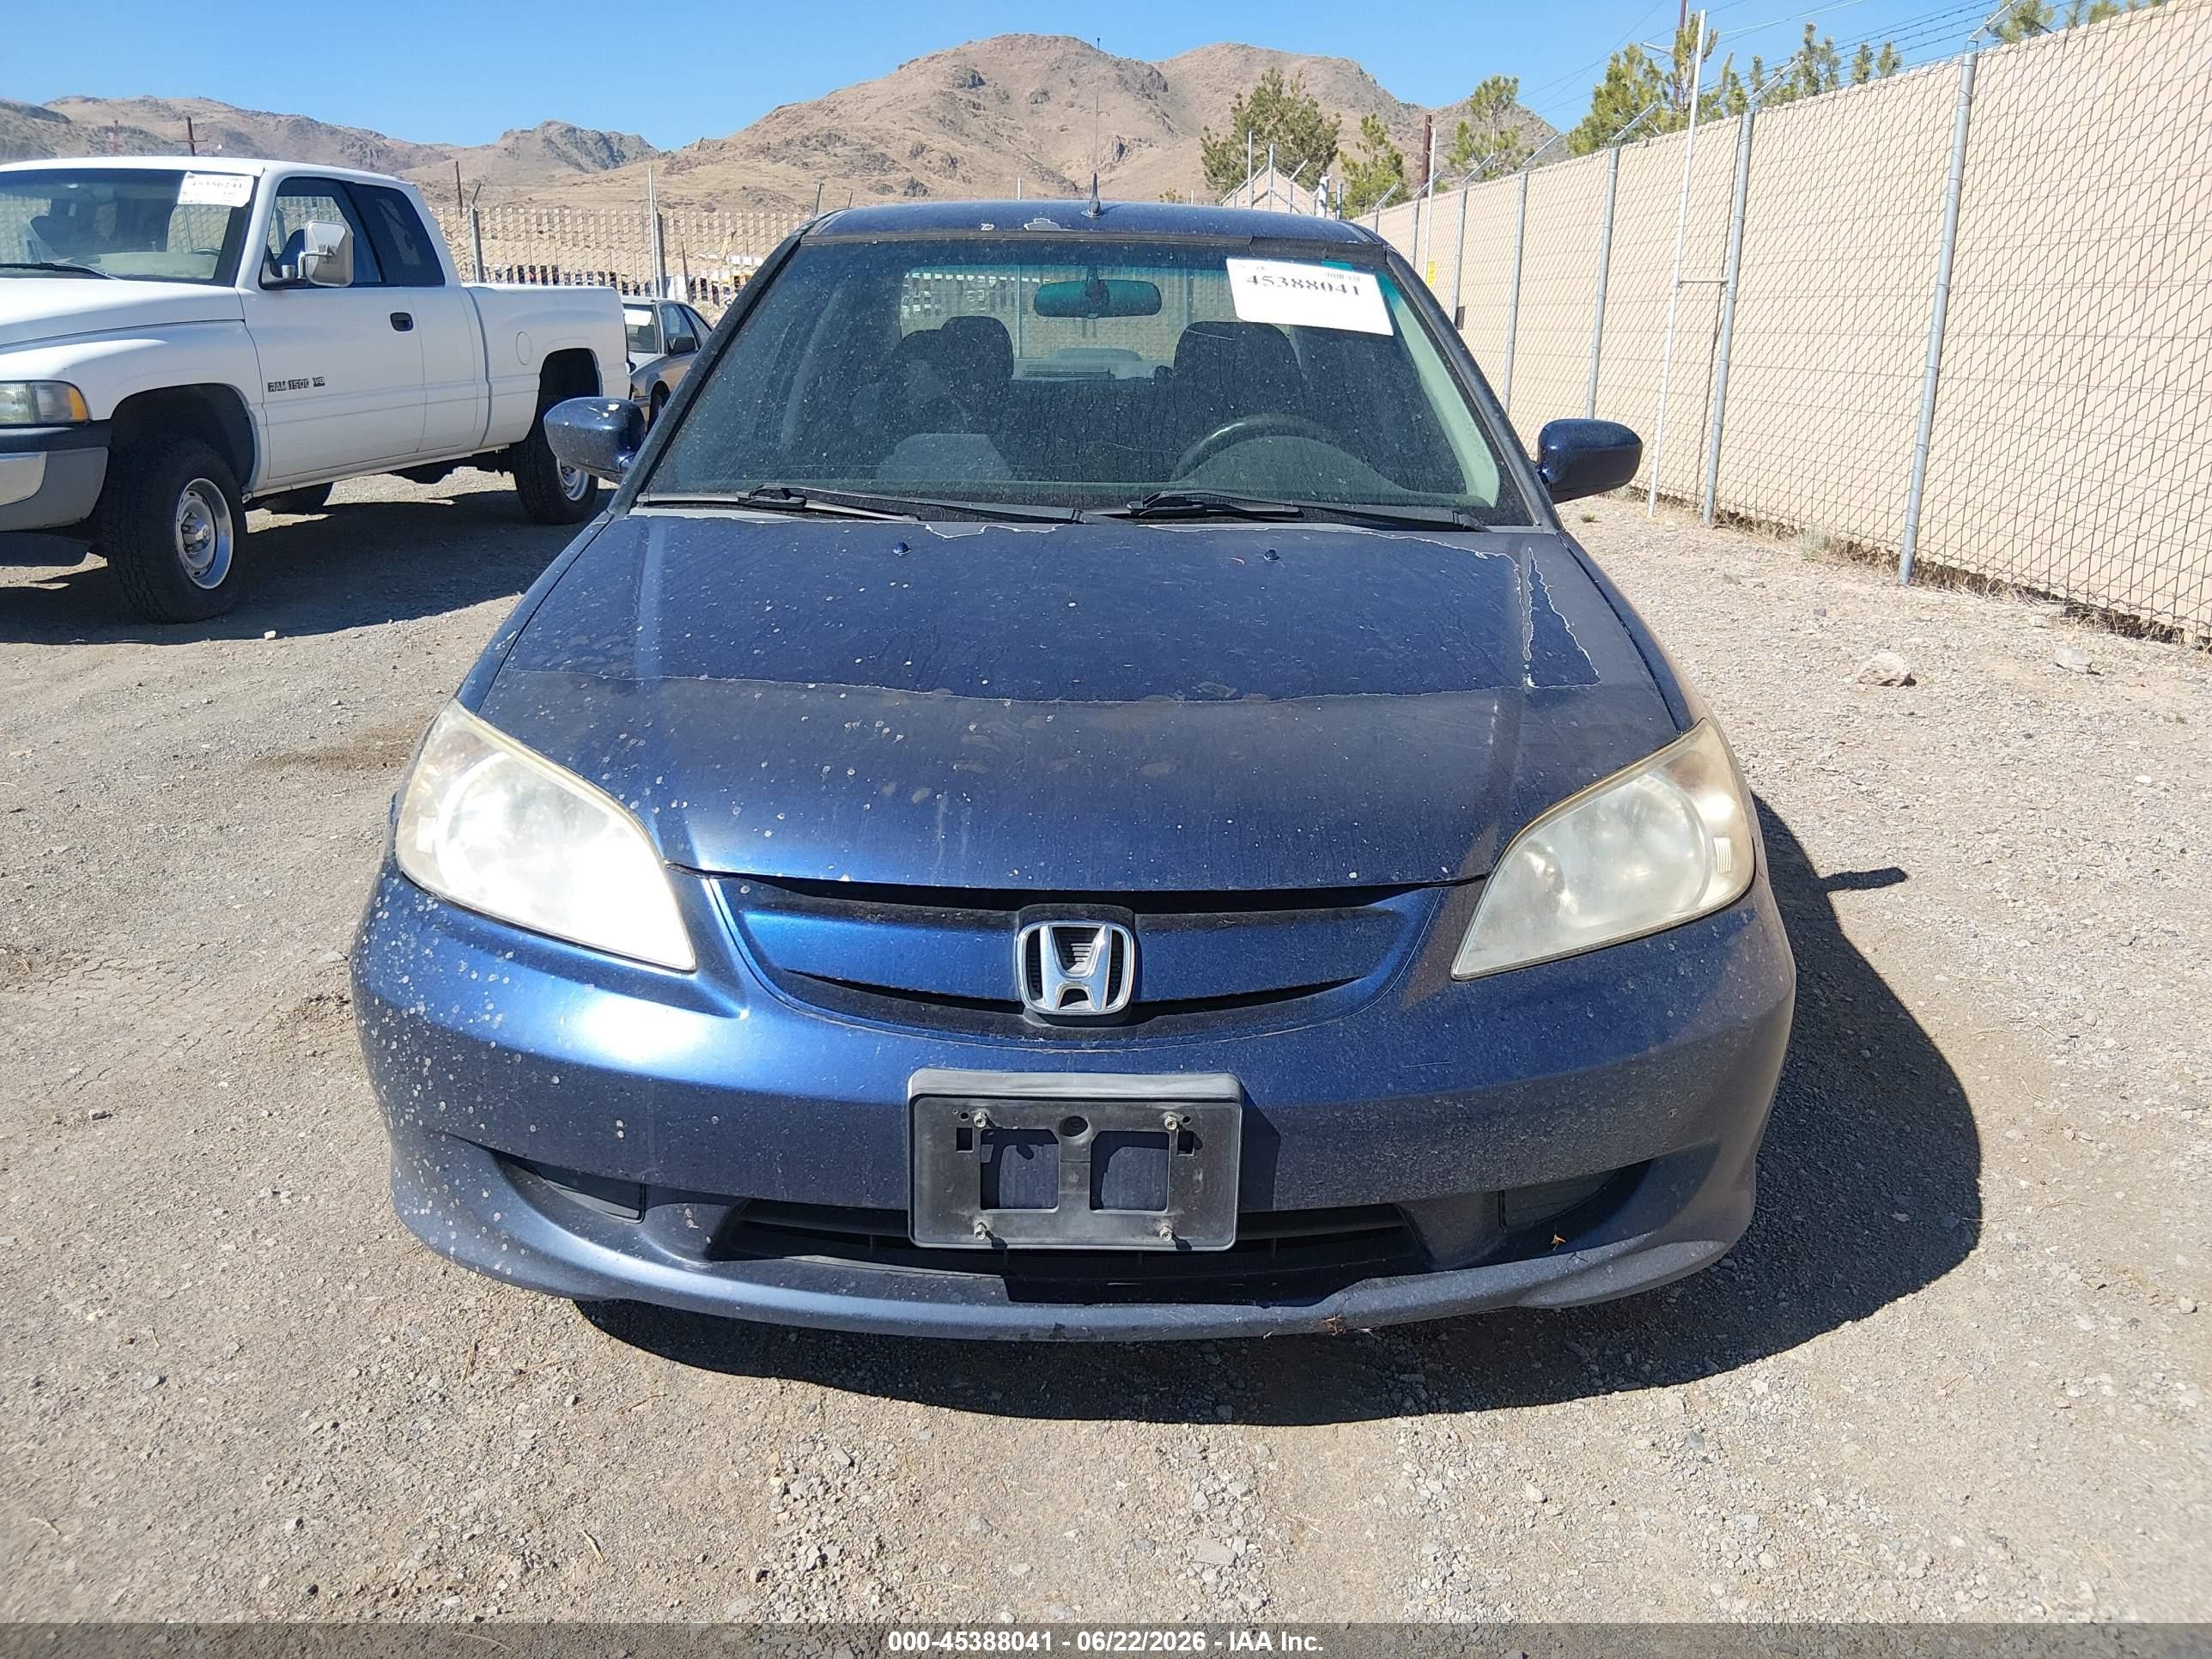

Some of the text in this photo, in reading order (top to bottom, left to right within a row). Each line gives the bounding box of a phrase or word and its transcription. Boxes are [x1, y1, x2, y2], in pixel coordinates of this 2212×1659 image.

[1246, 274, 1360, 295] 45388041
[267, 381, 287, 392] RAM
[288, 378, 309, 390] 1500
